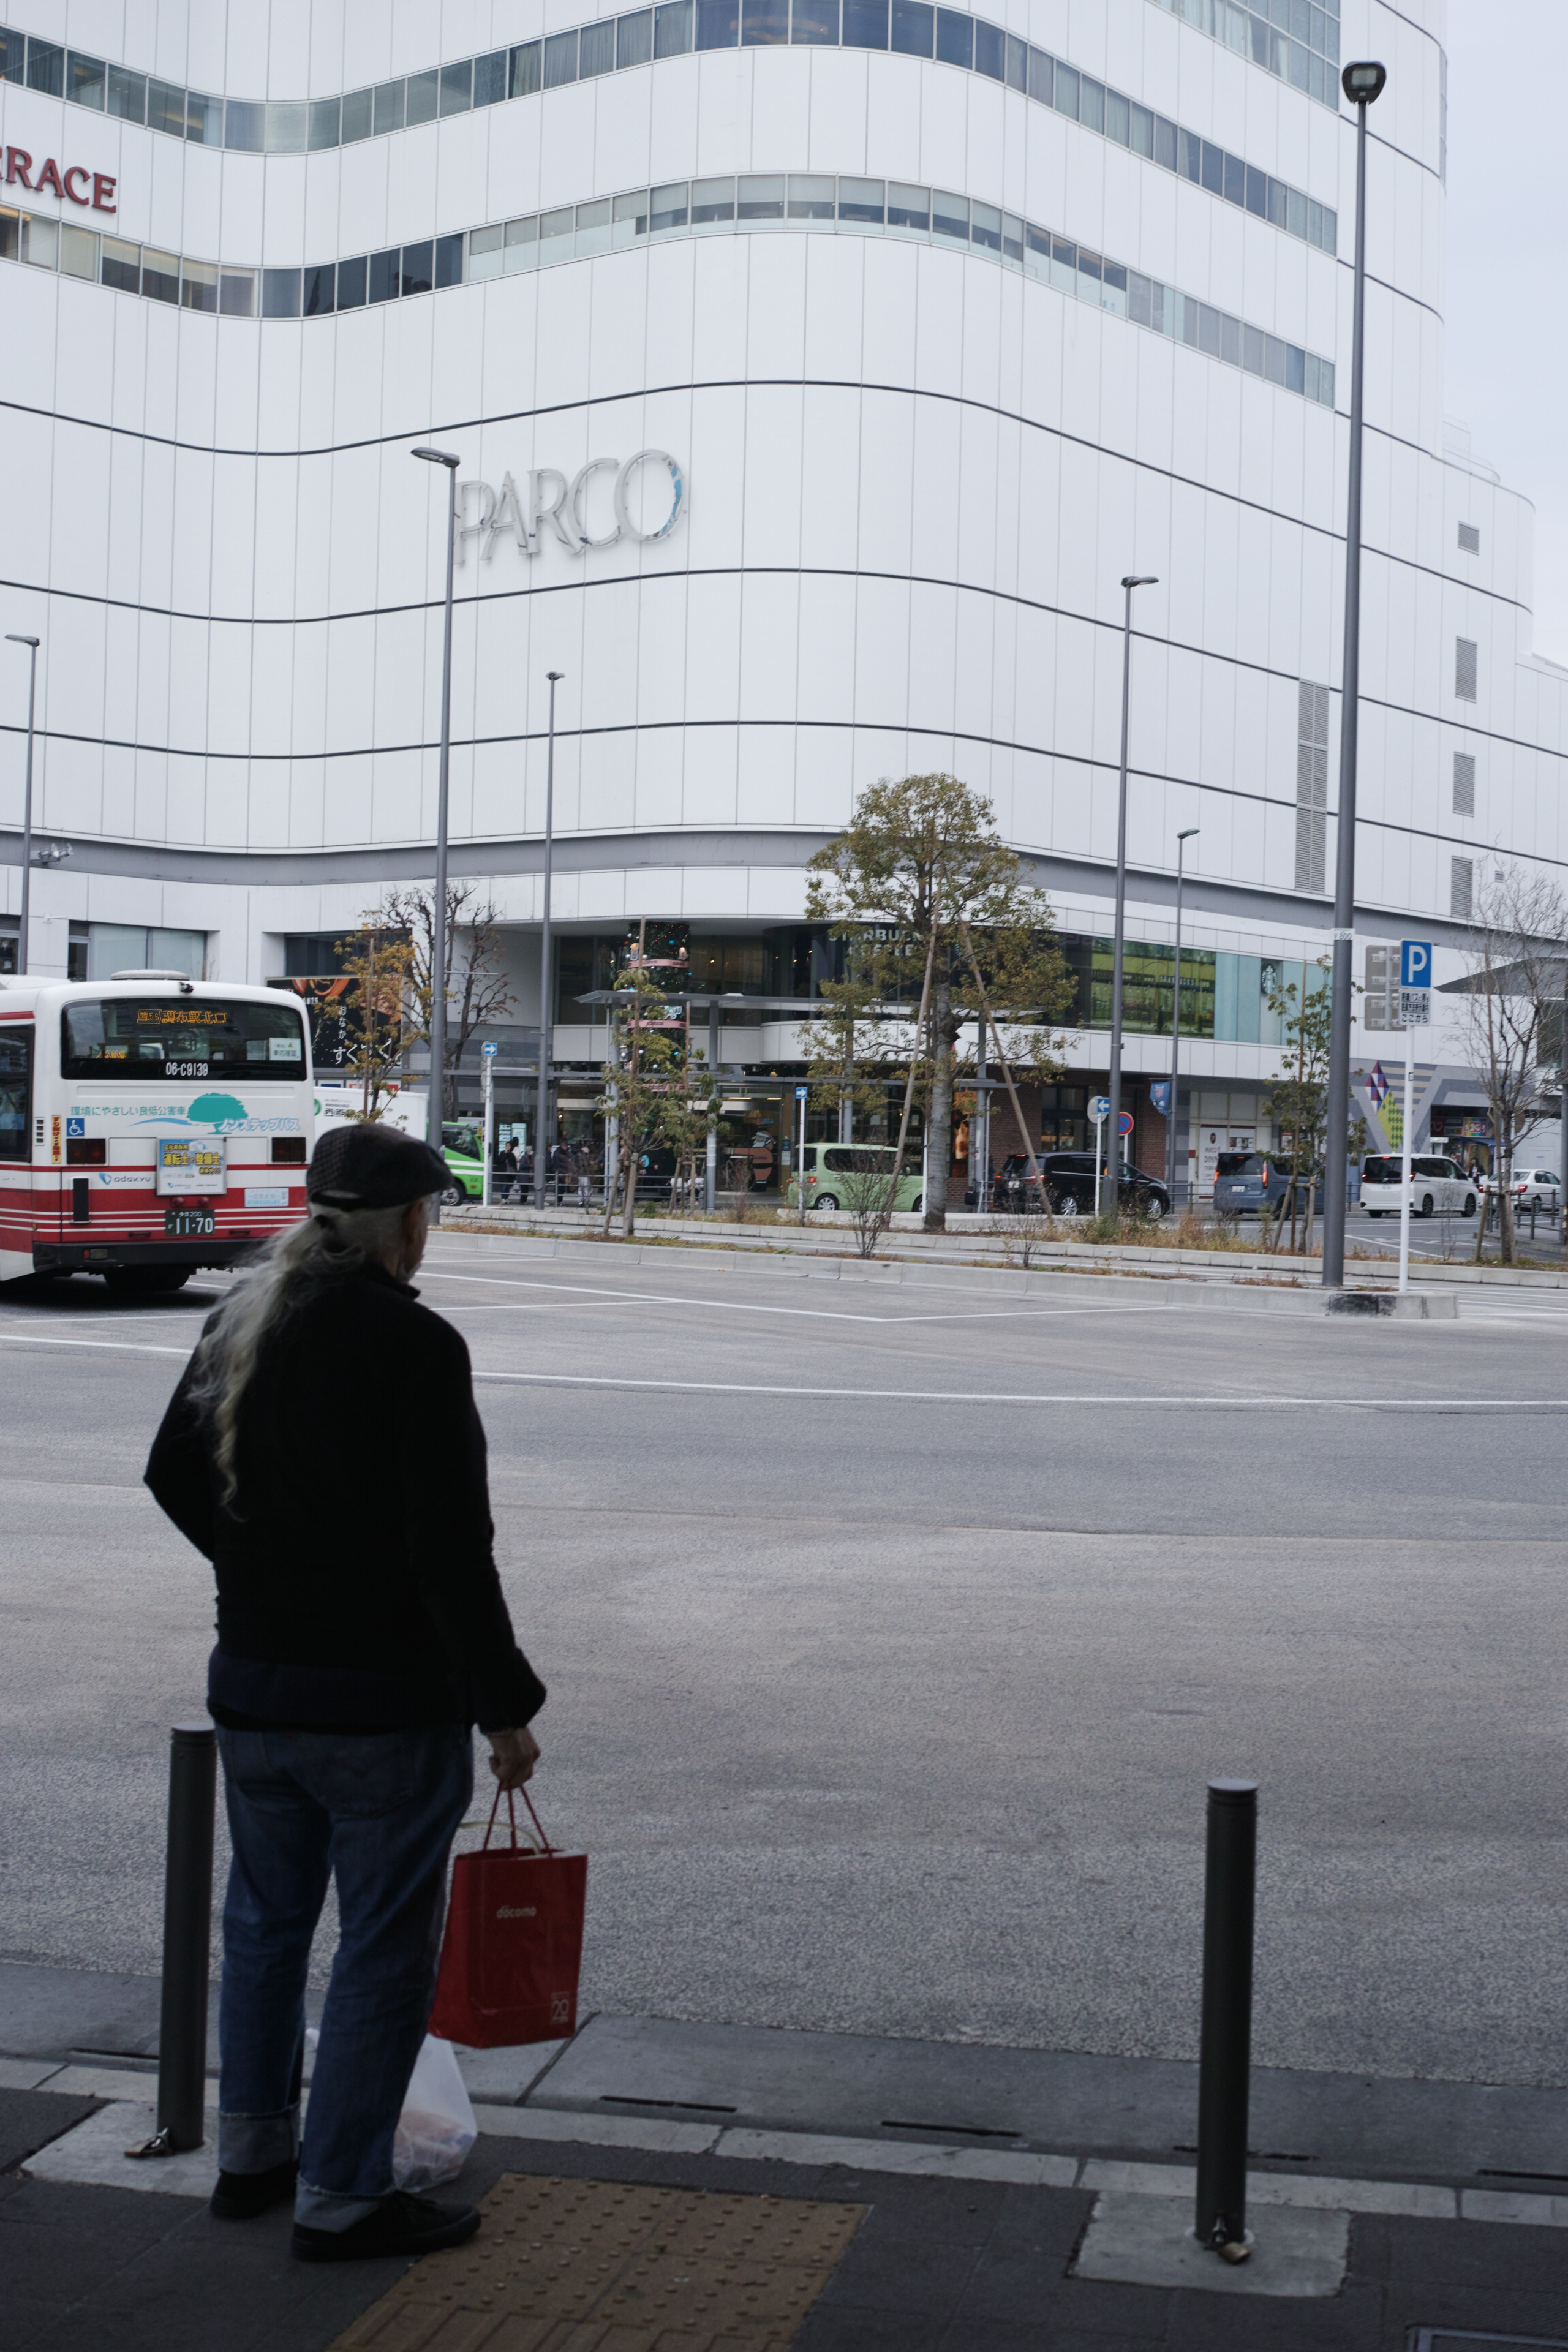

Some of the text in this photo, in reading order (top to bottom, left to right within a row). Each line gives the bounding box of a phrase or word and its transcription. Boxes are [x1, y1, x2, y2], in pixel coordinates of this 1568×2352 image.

[0, 145, 116, 213] RACE
[453, 448, 684, 565] PARCO
[1408, 945, 1427, 983] P
[1159, 976, 1195, 986] STARUCKS
[162, 1010, 227, 1024] 調布駅北口
[1401, 1014, 1428, 1023] ここから
[165, 1061, 208, 1076] 06-C9139
[217, 1117, 301, 1132] ノンステップバス
[163, 1152, 221, 1166] 運転士・整備士
[176, 1217, 213, 1234] 11-70
